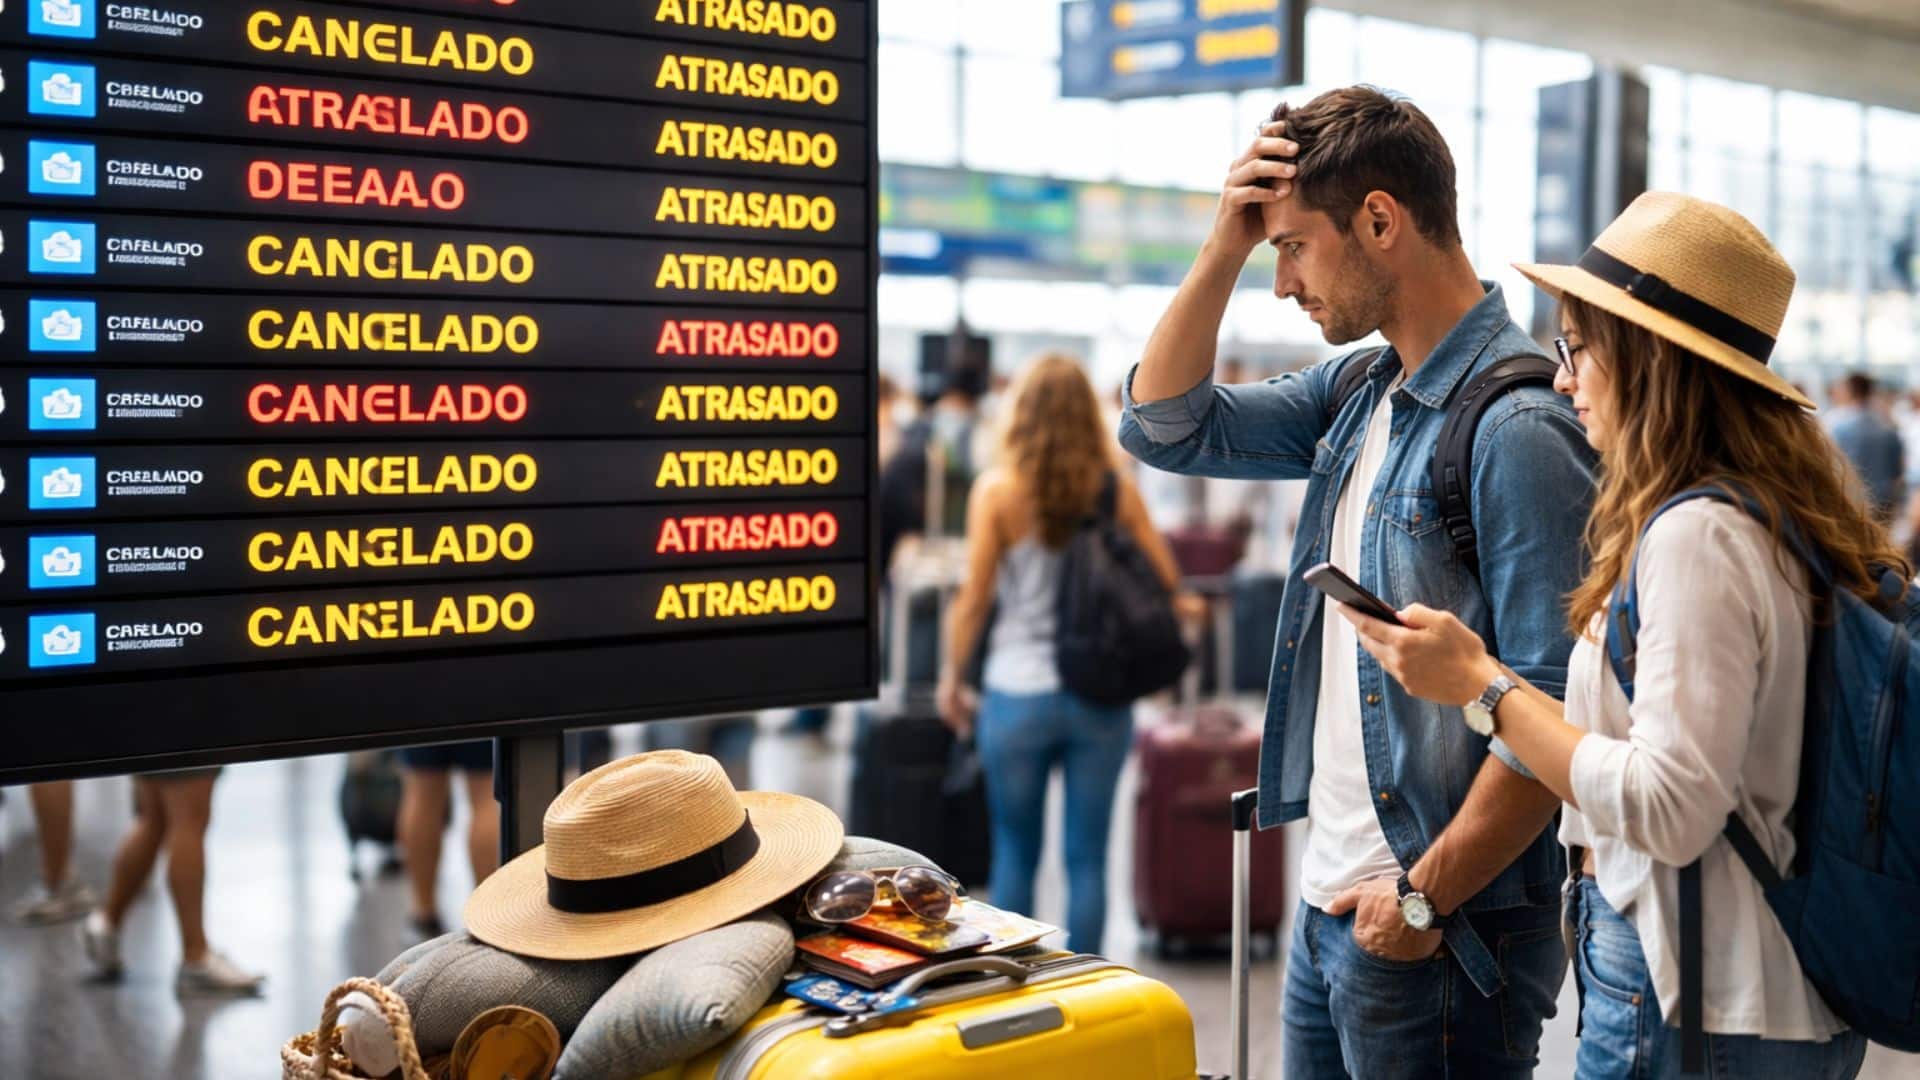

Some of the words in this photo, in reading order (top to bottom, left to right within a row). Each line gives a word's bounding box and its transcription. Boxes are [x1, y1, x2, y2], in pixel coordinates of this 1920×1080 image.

[656, 0, 836, 41] ATRASADO
[656, 55, 838, 104] ATRASADO
[656, 120, 837, 168] ATRASADO
[656, 187, 836, 231] ATRASADO
[656, 254, 837, 295] ATRASADO
[656, 320, 838, 358] ATRASADO
[656, 386, 838, 420] ATRASADO
[656, 449, 837, 487] ATRASADO
[656, 512, 838, 553] ATRASADO
[656, 576, 836, 620] ATRASADO
